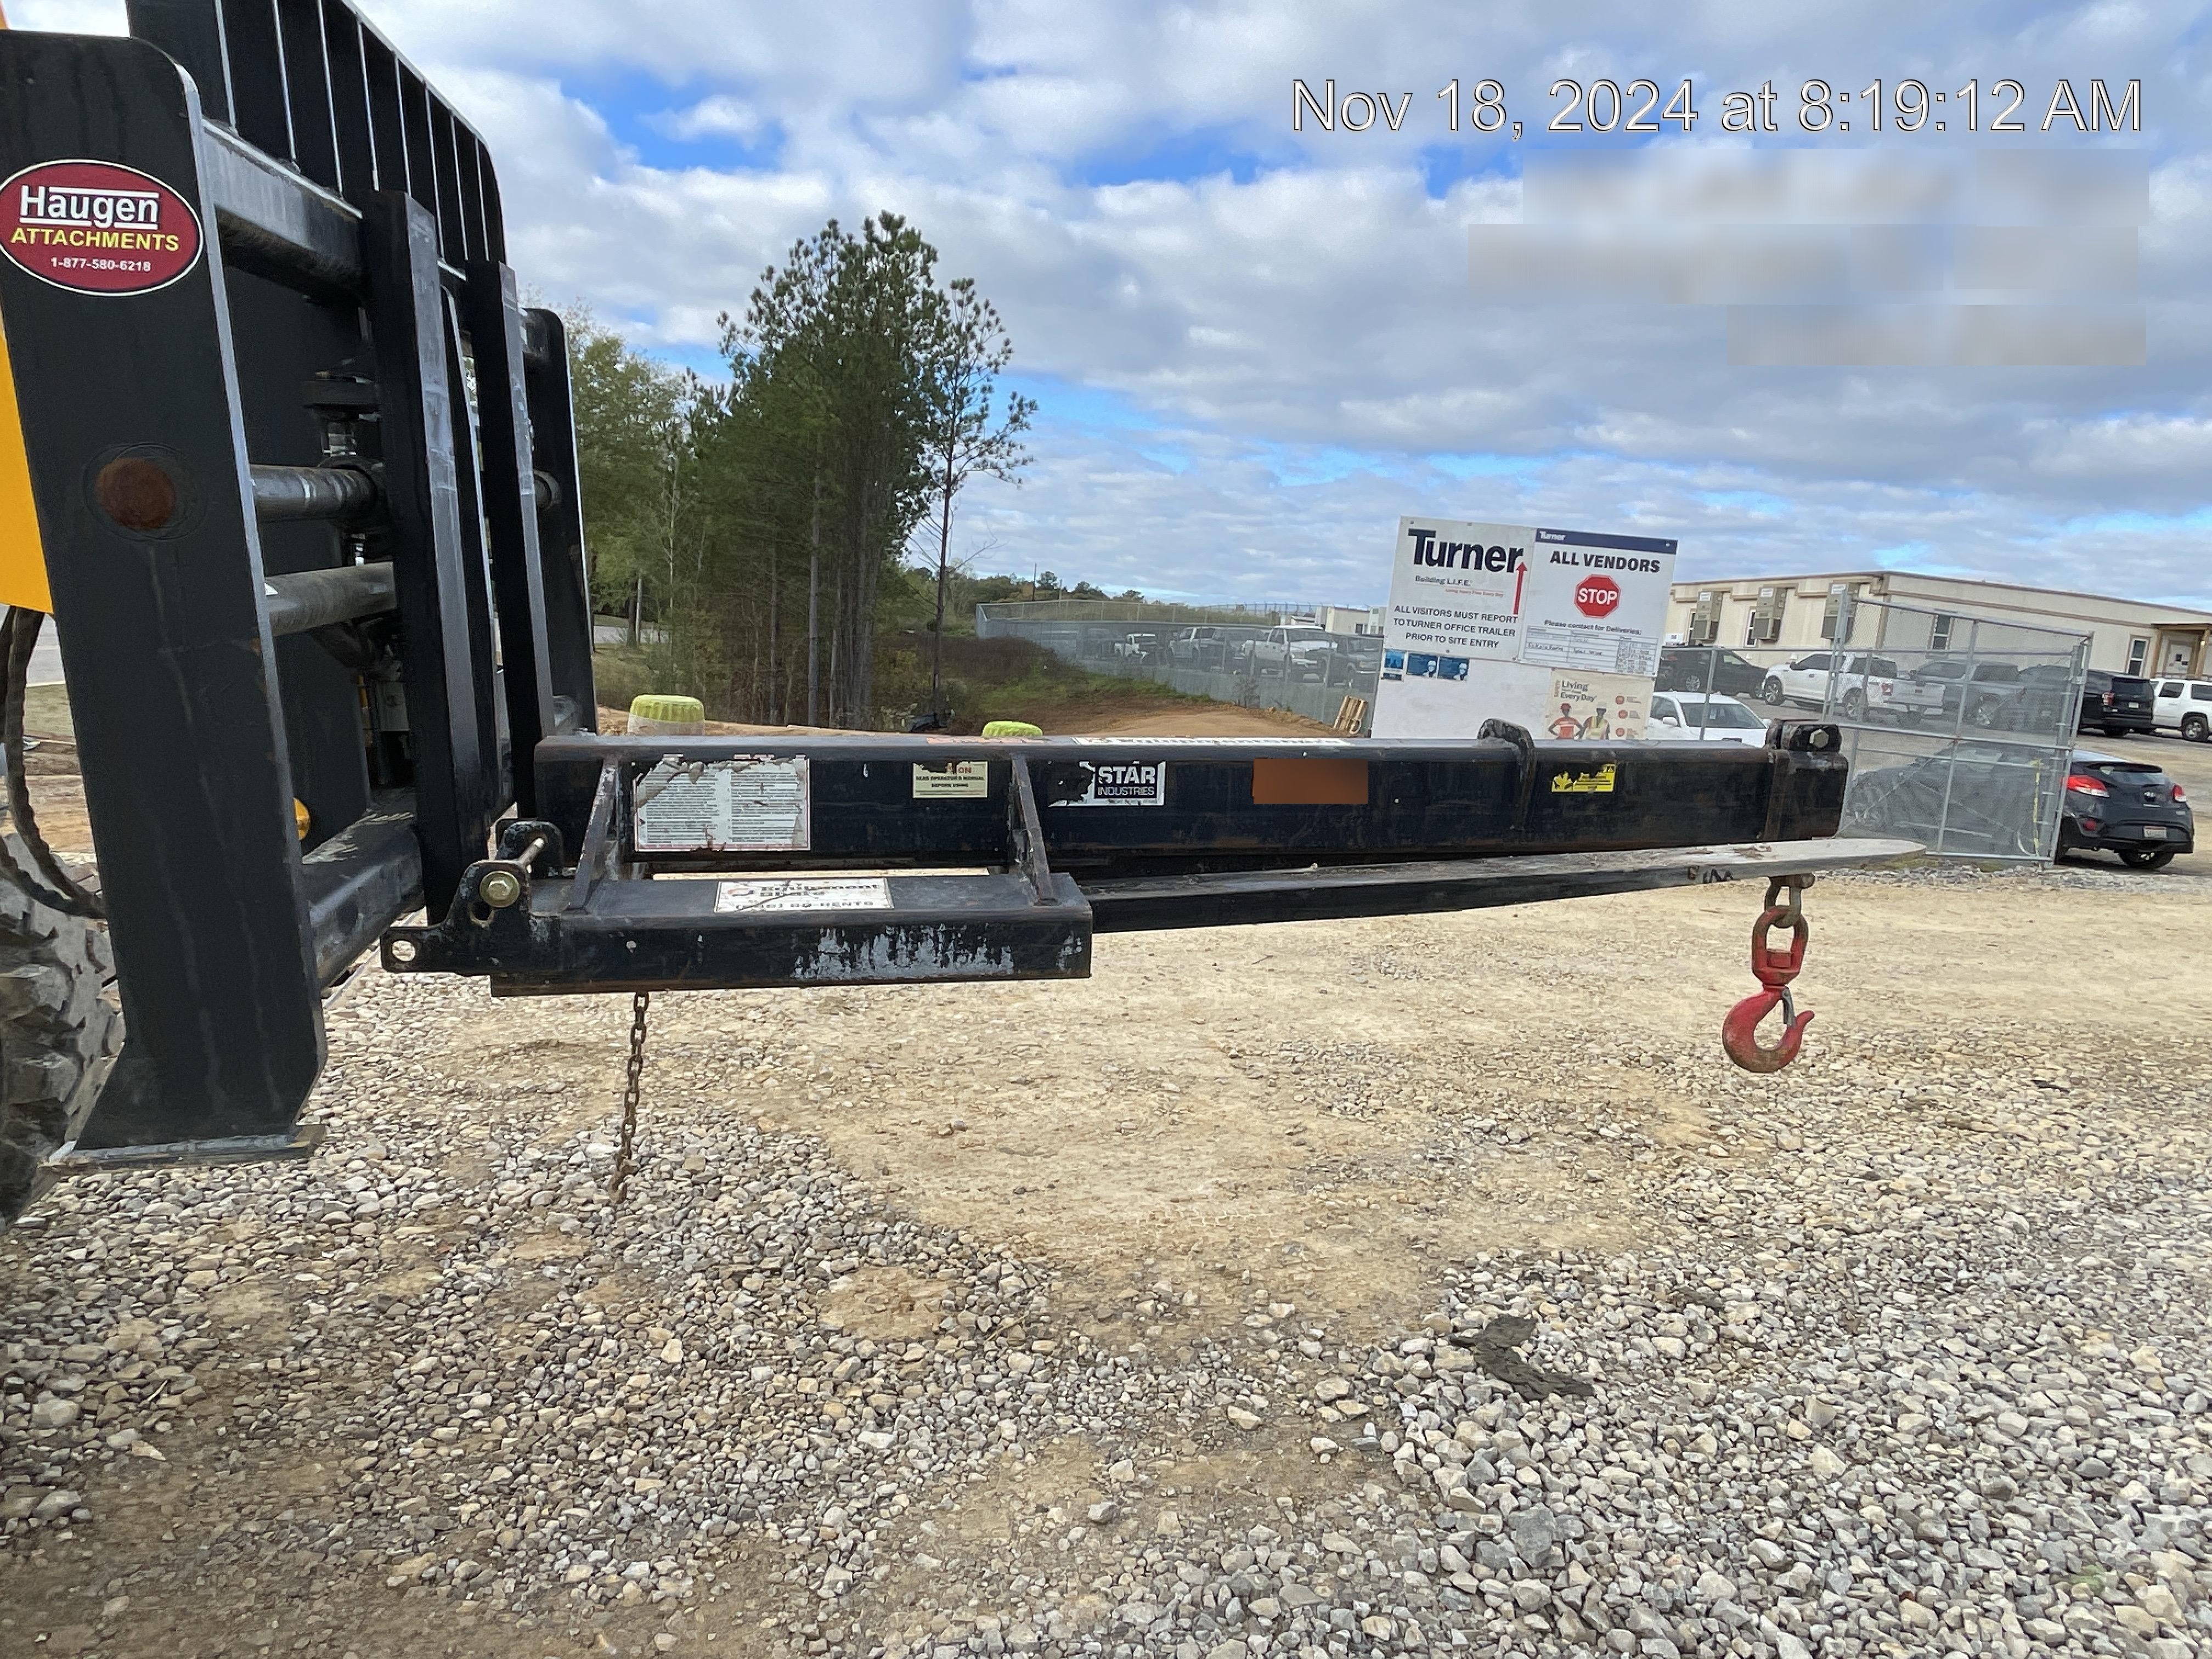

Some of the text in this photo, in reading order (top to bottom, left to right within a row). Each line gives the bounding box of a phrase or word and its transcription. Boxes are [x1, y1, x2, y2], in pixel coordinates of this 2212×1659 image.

[20, 185, 159, 228] Haugen
[11, 228, 180, 251] ATTACHMENTS
[51, 257, 151, 272] 1-877-580-6218
[1539, 531, 1566, 541] Turner
[1408, 528, 1524, 573] Turner
[1550, 551, 1660, 573] ALL VENDORS
[1578, 588, 1617, 605] STOP
[1394, 605, 1518, 623] ALL VISITORS MUST REPORT
[1394, 618, 1515, 636] TO TURNER OFFICE TRAILER
[1406, 633, 1432, 641] PRIOR
[1448, 636, 1466, 645] SITE
[1470, 639, 1499, 648] ENTRY
[1562, 680, 1589, 691] Living
[1098, 766, 1155, 784] STAR
[1097, 787, 1154, 795] INDUSTRIES
